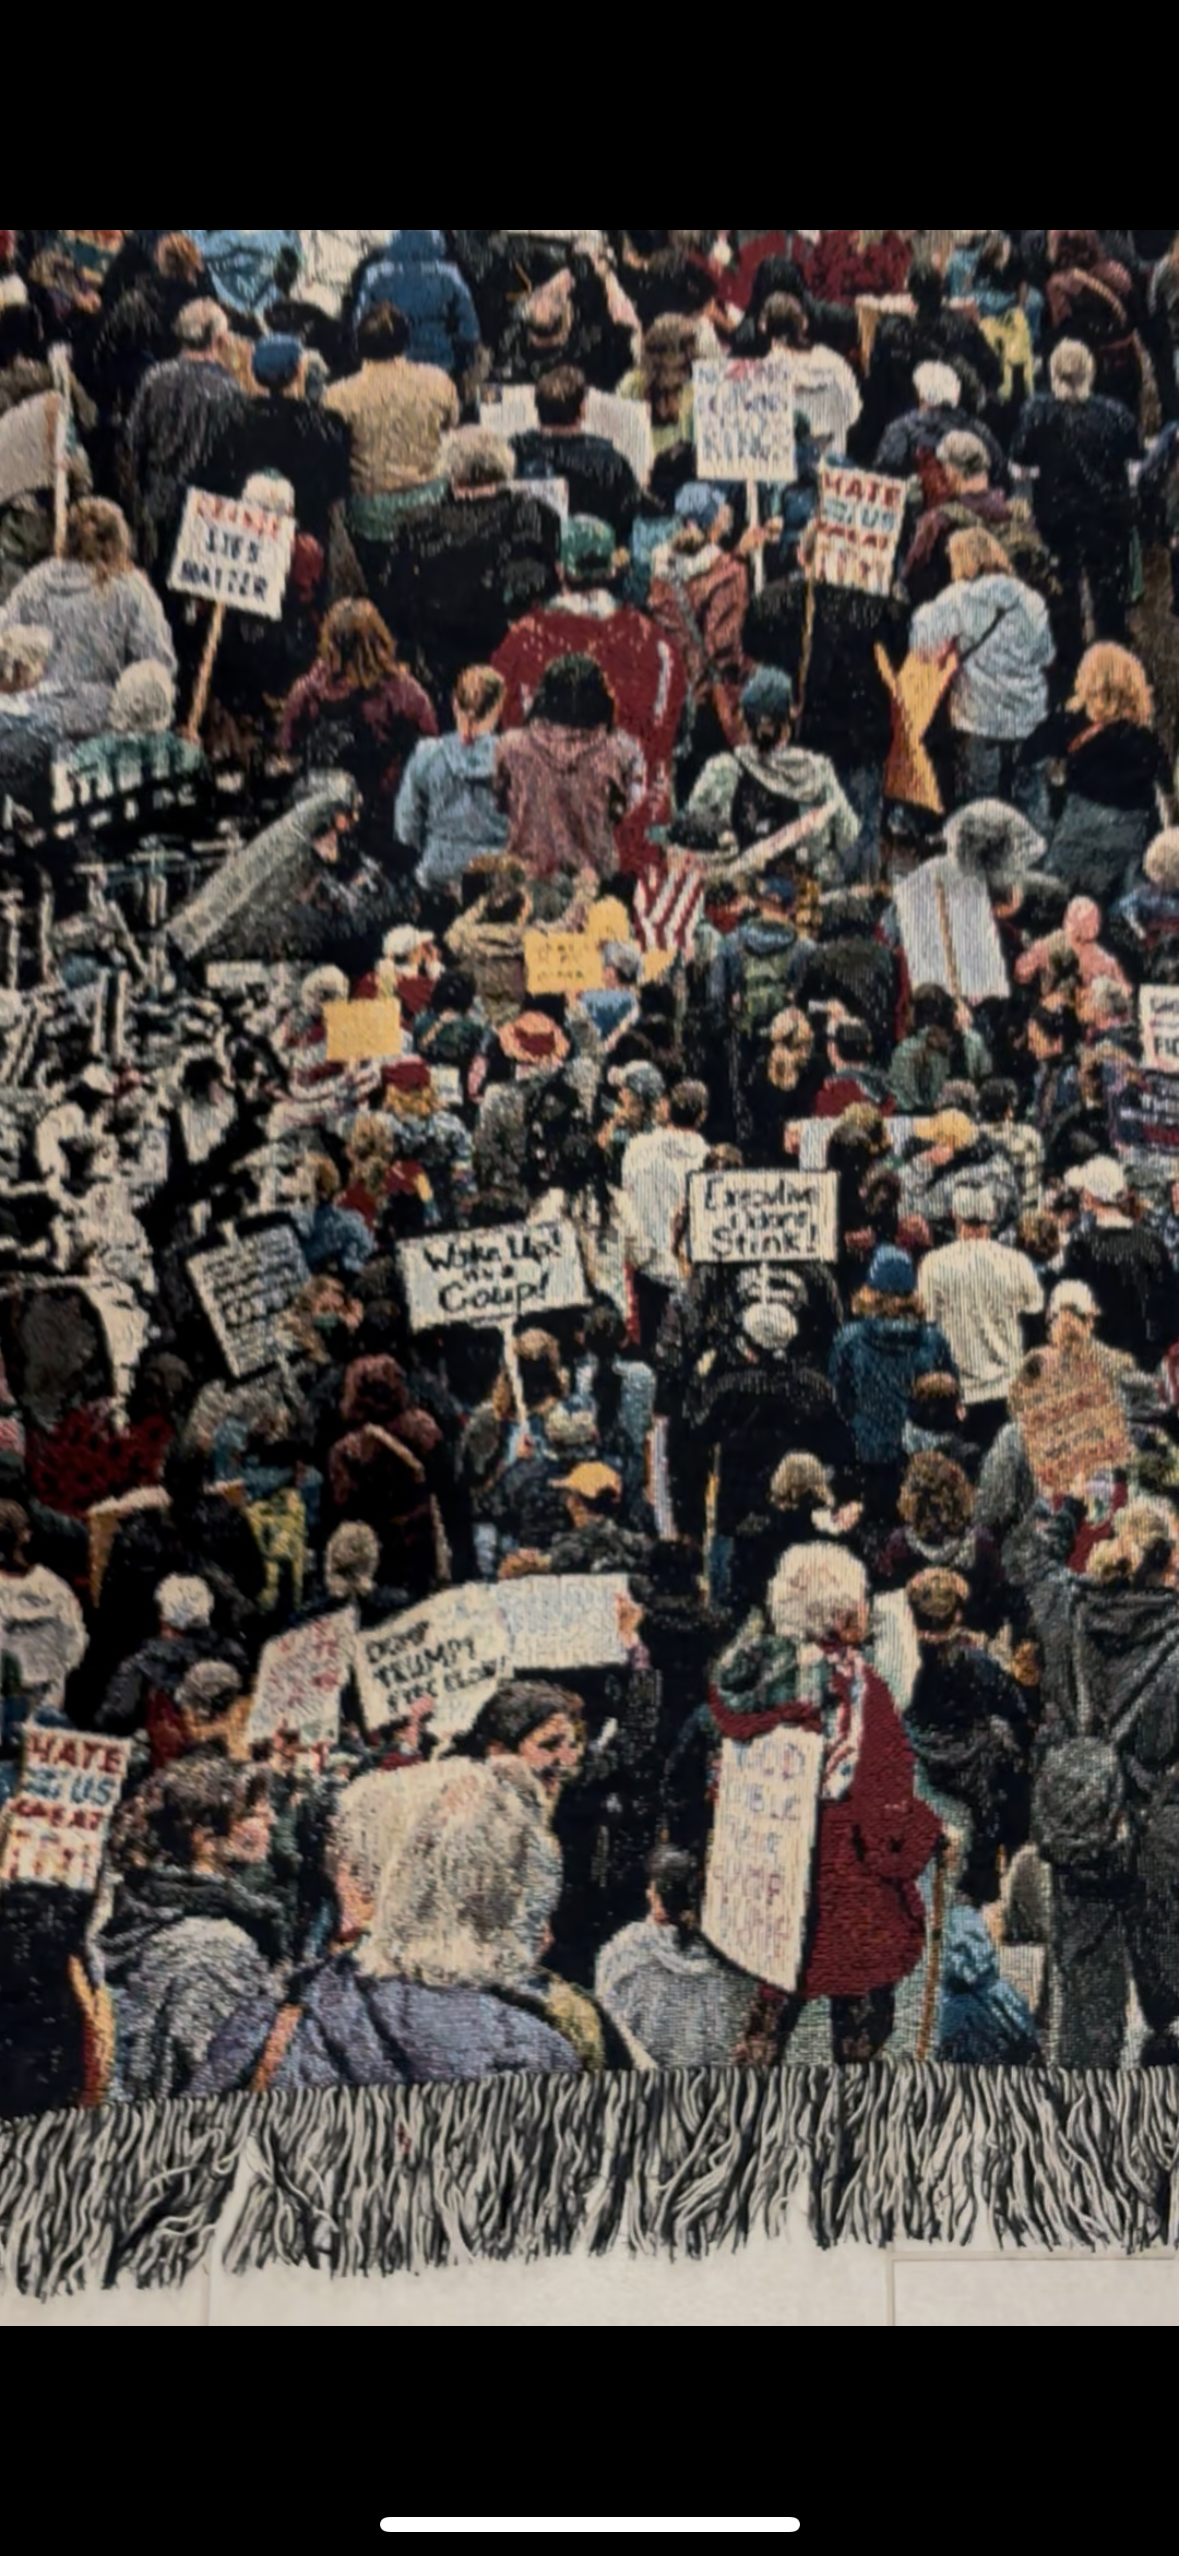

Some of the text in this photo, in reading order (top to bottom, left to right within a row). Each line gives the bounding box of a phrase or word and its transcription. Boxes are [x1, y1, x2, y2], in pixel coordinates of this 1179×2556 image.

[822, 470, 902, 508] HATE
[180, 560, 269, 602] MATTER
[422, 1228, 561, 1272] Wake Up!
[711, 1223, 817, 1256] Stink!
[437, 1270, 551, 1315] Coup!
[25, 1732, 123, 1774] HATE
[70, 1775, 116, 1807] US
